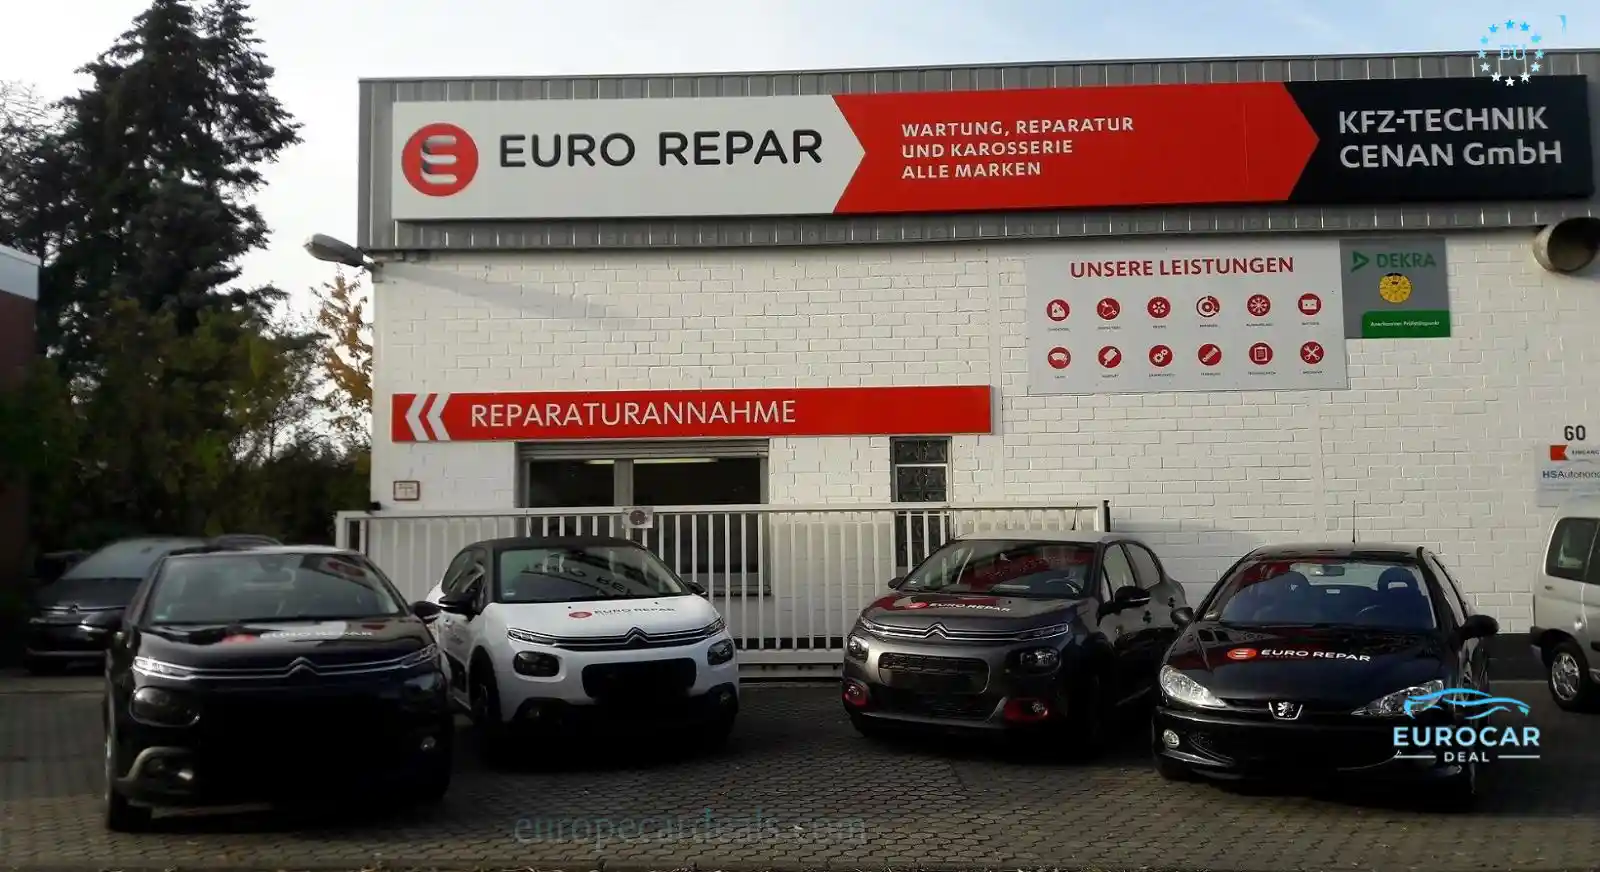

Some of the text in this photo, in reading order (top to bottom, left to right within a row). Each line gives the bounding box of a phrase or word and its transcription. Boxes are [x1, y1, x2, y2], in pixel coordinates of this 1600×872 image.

[901, 116, 1134, 138] WARTUNG, REPARATUR
[1338, 106, 1549, 134] KFZ-TECHNIK
[499, 129, 823, 167] EURO REPAR
[902, 139, 1073, 158] UND KAROSSERIE
[1339, 139, 1563, 168] CENAN GmbH
[901, 161, 1041, 180] ALLE MARKEN
[1070, 256, 1294, 278] UNSERE LEISTUNGEN
[1376, 252, 1437, 268] DEKRA
[470, 399, 797, 428] REPARATURANNAHME
[1564, 425, 1586, 441] 60
[1261, 649, 1371, 662] EURO REPAR
